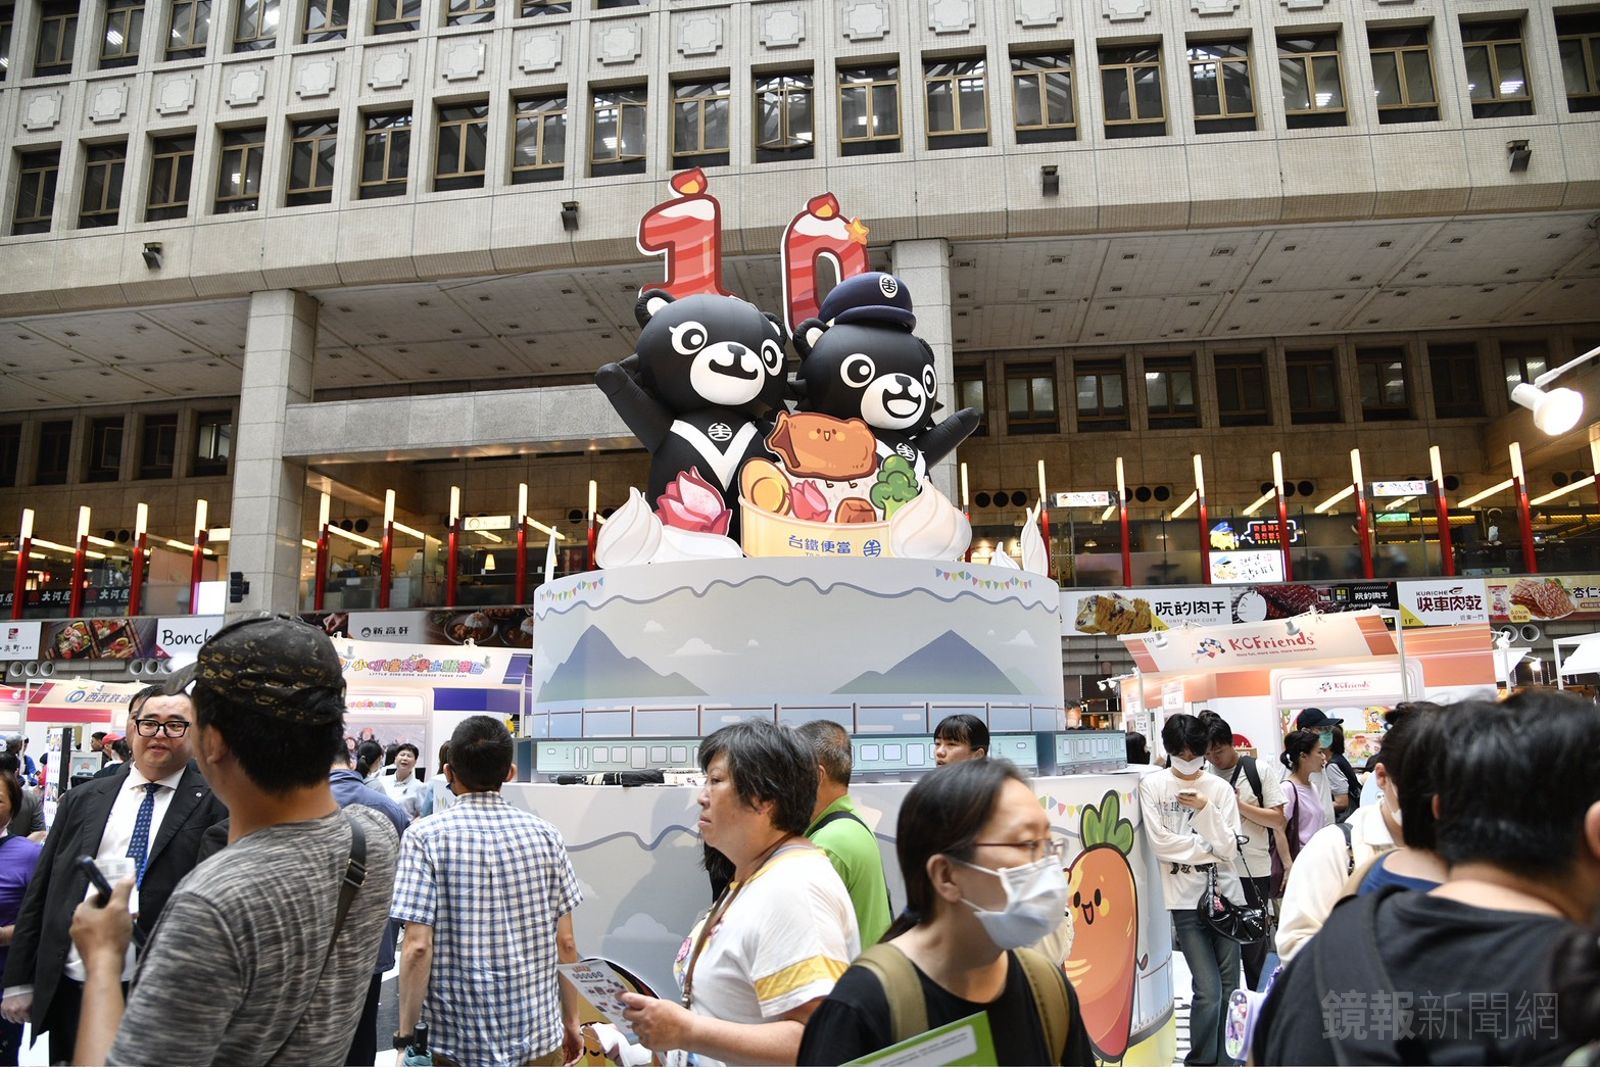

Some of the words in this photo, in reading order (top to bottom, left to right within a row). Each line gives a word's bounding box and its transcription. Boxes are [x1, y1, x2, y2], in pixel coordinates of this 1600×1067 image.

[788, 535, 851, 554] 台鐵便當
[42, 591, 71, 601] 大河屋
[99, 589, 129, 600] 大河屋
[1573, 586, 1600, 598] 杏仁
[1155, 600, 1226, 617] 阮的肉干
[1417, 595, 1483, 613] 快車肉乾
[1228, 632, 1315, 651] KCFriends
